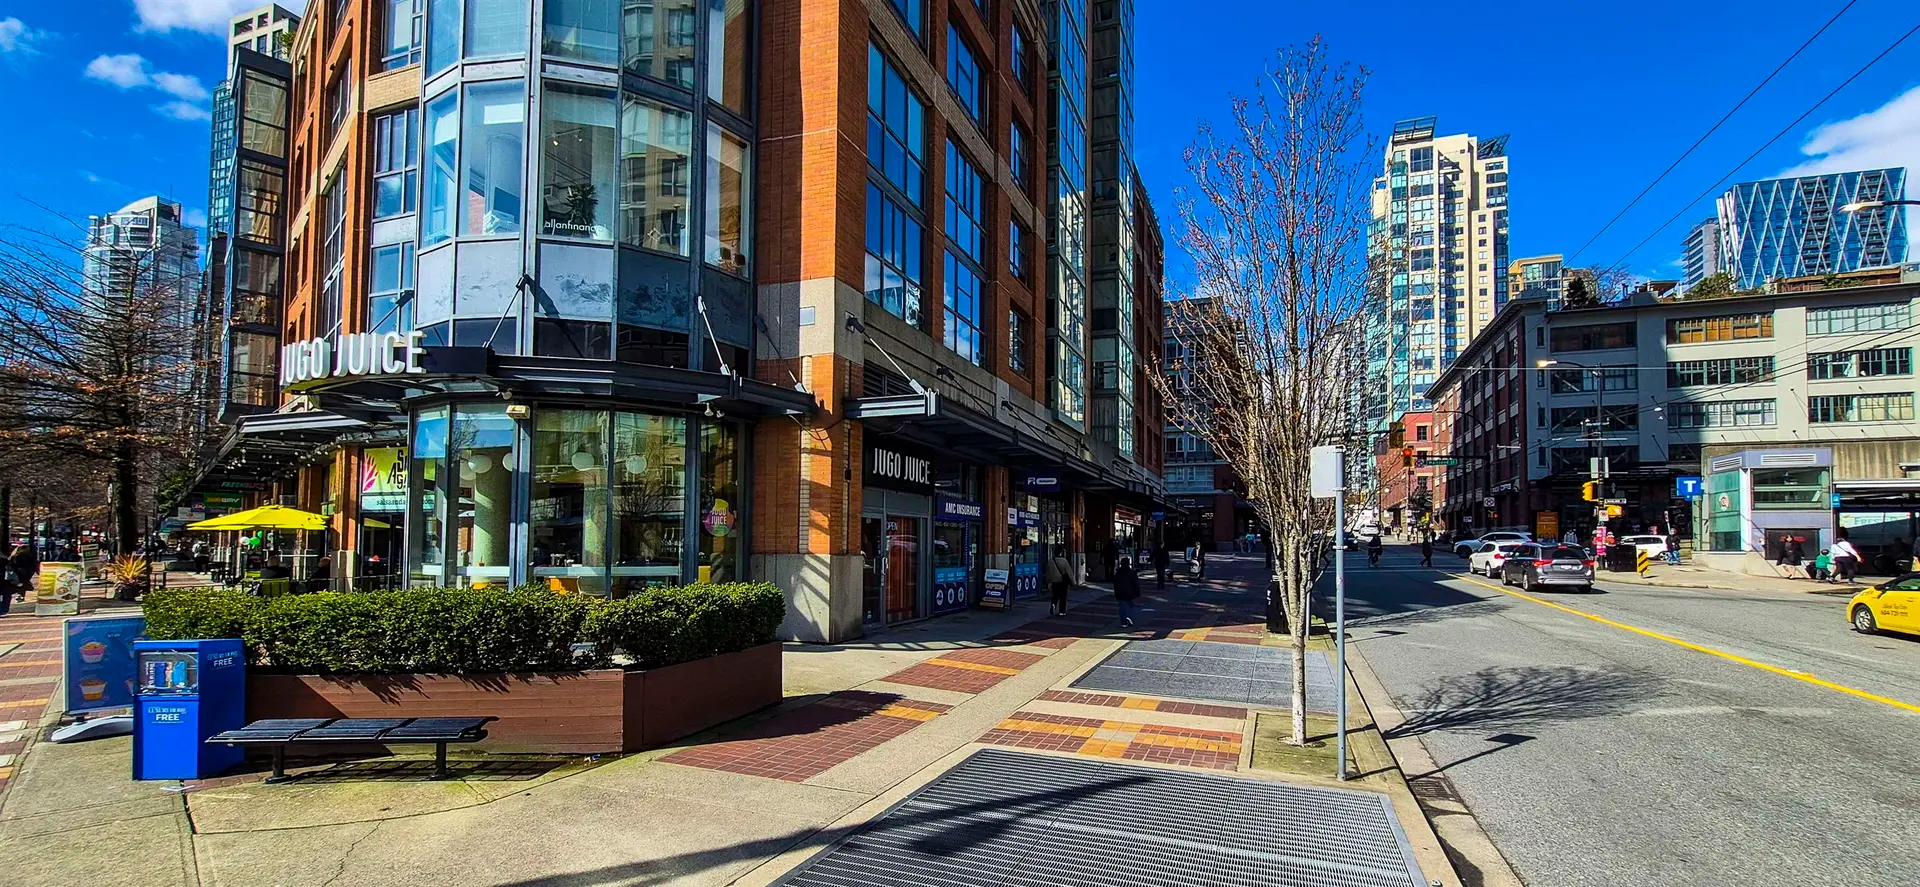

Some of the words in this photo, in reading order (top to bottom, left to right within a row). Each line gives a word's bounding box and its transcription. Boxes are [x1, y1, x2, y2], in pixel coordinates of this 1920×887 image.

[280, 337, 330, 387] JUGO
[333, 330, 427, 378] JUICE
[873, 447, 901, 479] JUGO
[904, 455, 930, 485] JUICE
[1684, 480, 1697, 493] T
[944, 501, 957, 514] AMC
[956, 503, 981, 517] INSURANCE
[711, 516, 727, 525] JUICE
[213, 657, 233, 668] FREE
[155, 713, 180, 722] FREE
